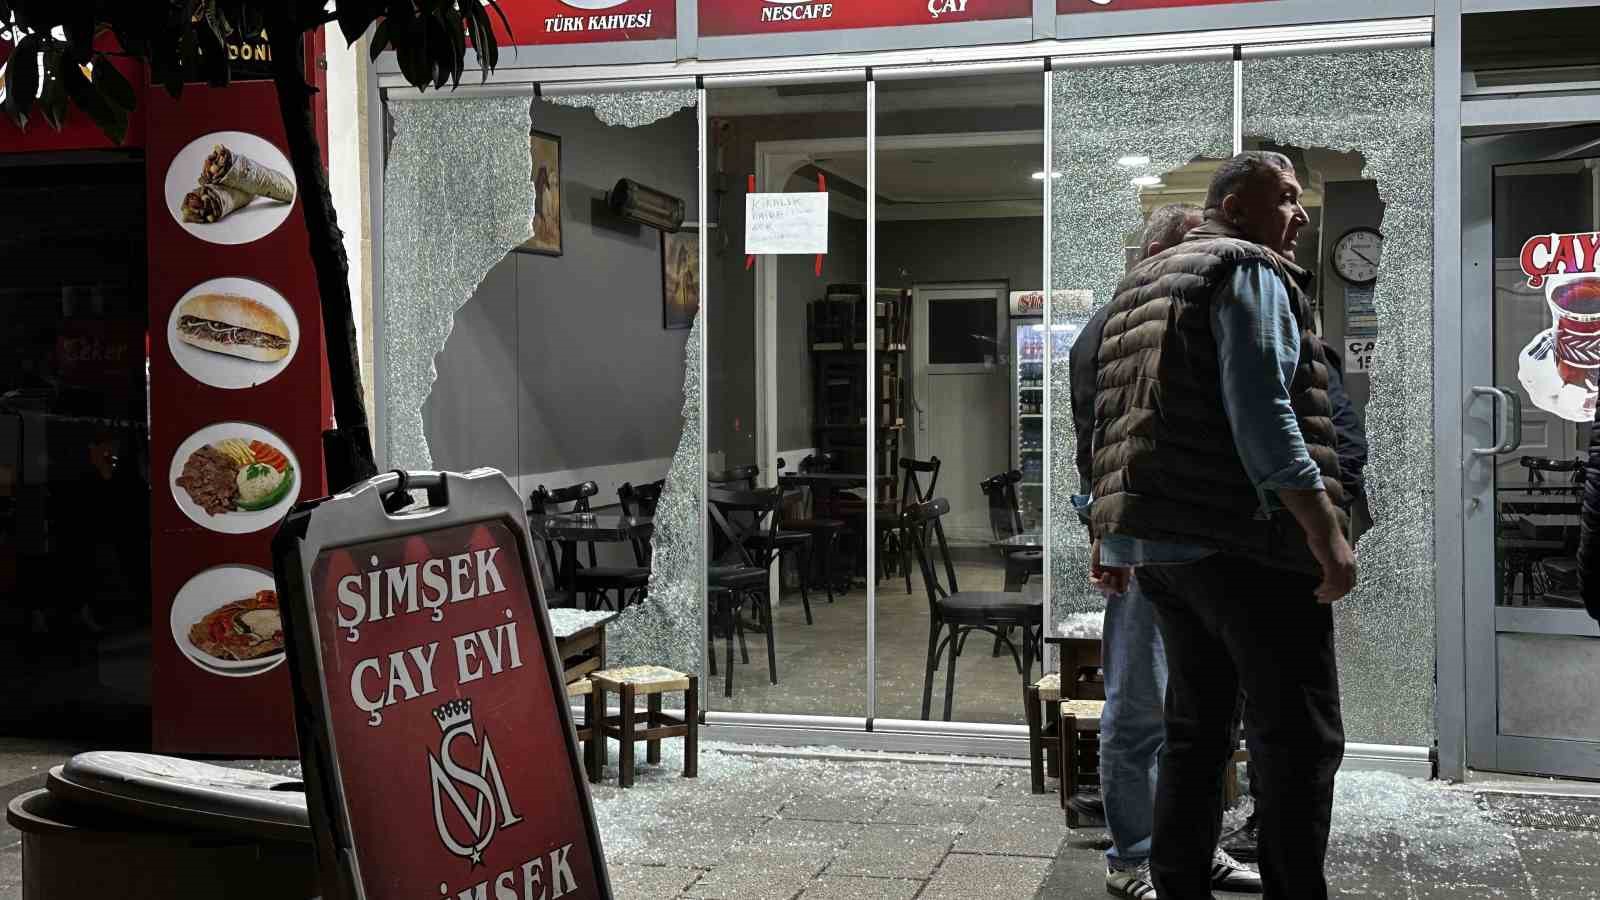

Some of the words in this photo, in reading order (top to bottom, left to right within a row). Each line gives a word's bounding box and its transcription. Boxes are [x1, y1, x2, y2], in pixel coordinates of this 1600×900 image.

[544, 13, 584, 32] TÜRK
[587, 9, 652, 31] KAHVESİ
[760, 3, 833, 22] NESCAFE
[927, 0, 969, 18] ÇAY
[1519, 233, 1600, 288] ÇAY
[1349, 341, 1375, 355] ÇA
[336, 547, 507, 642] ŞİMŞEK
[350, 641, 440, 726] ÇAY
[453, 608, 523, 685] EVİ
